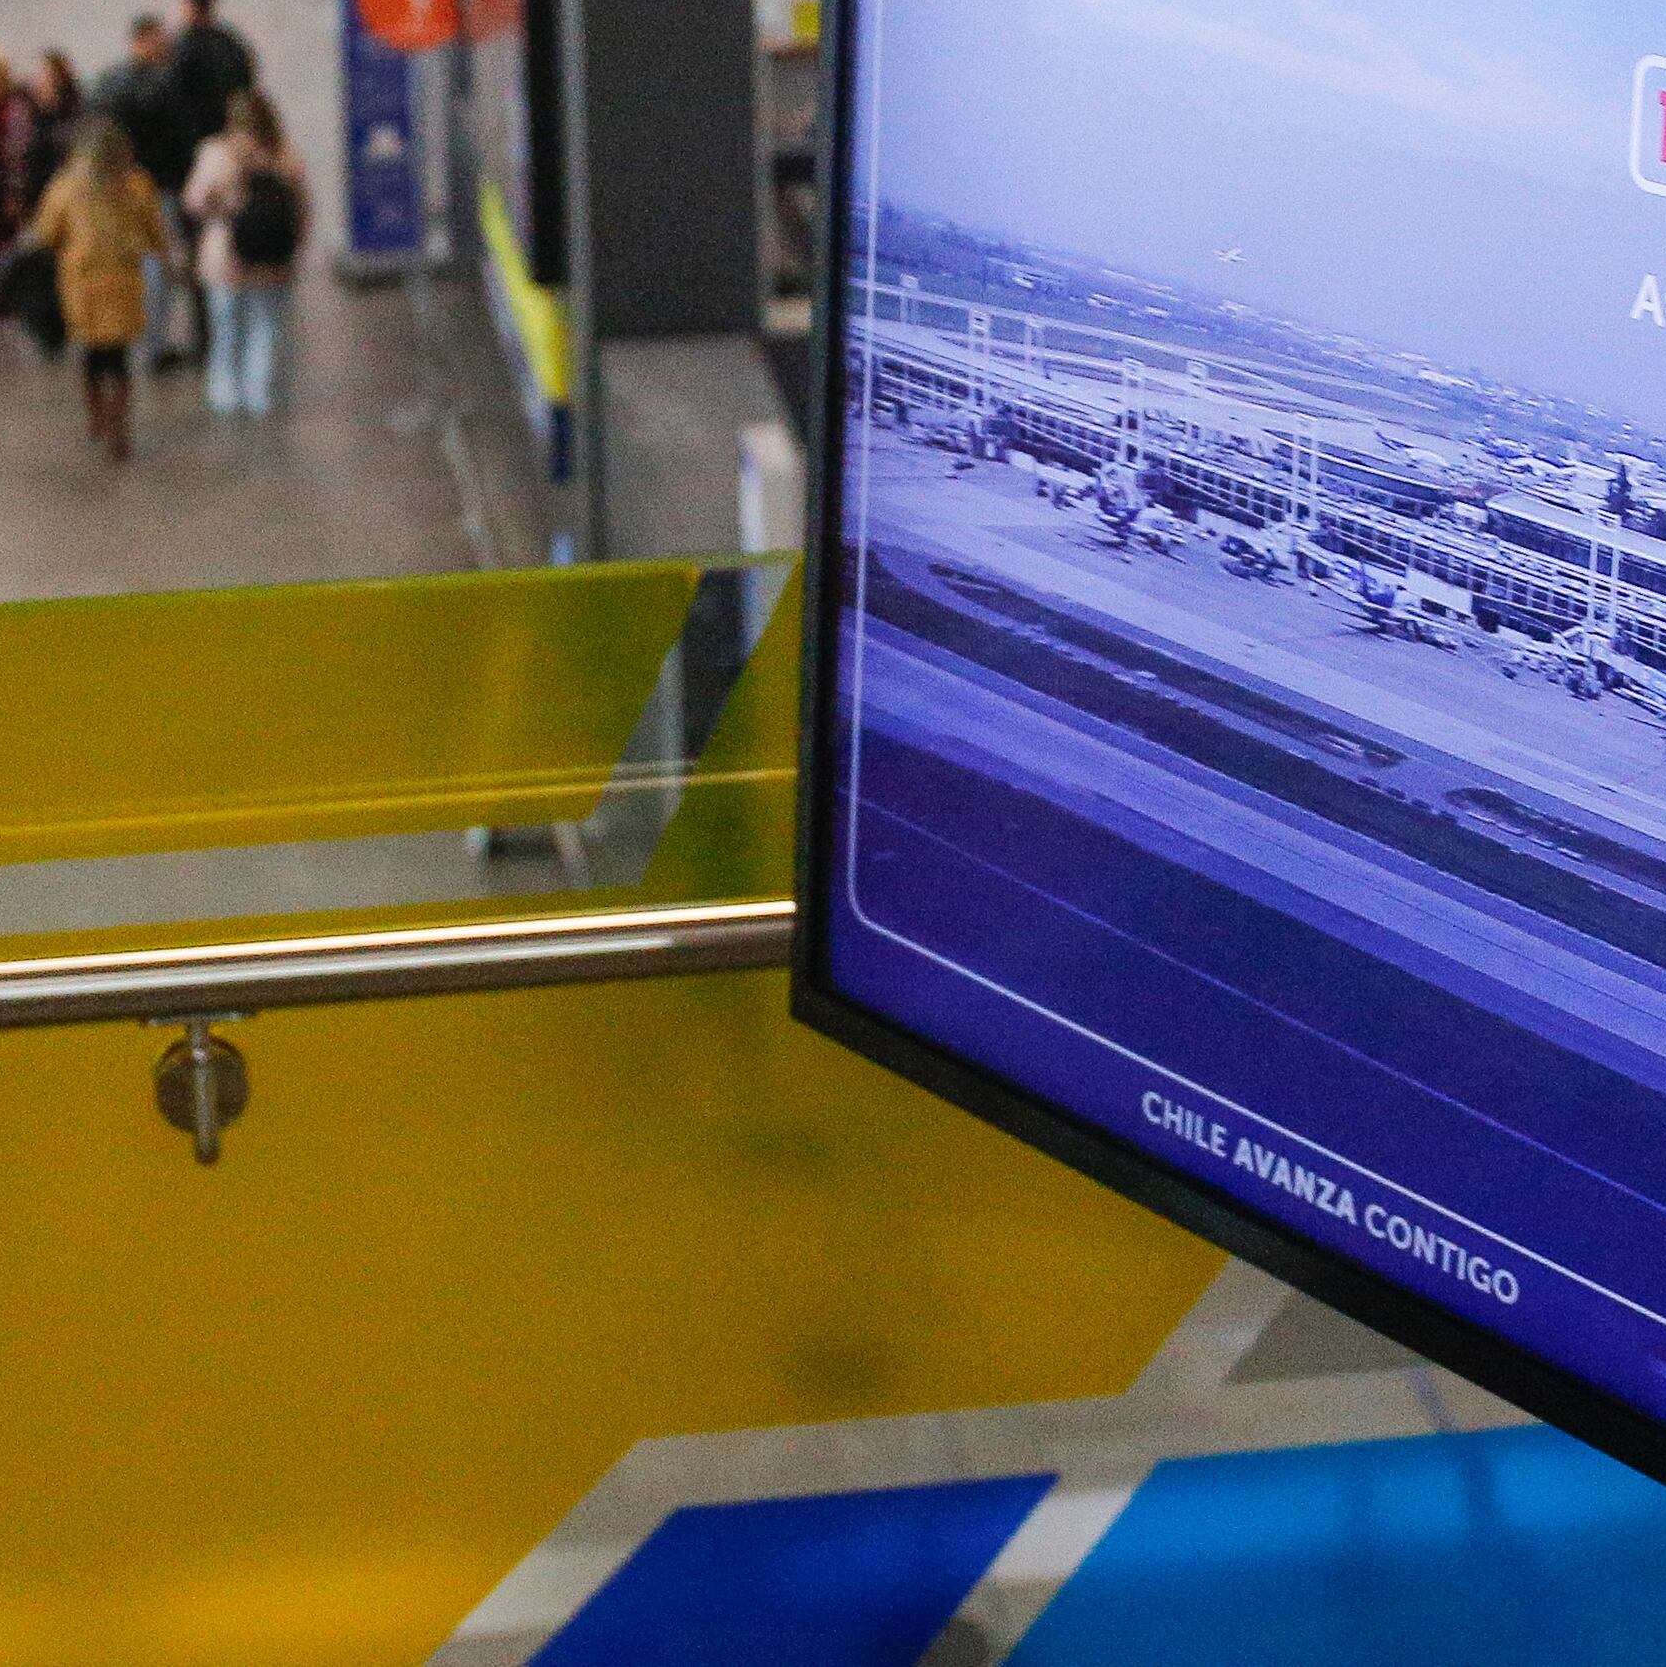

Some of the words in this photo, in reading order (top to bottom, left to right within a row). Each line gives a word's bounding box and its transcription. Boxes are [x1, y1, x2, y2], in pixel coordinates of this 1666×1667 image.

[1141, 1090, 1227, 1158] CHILE
[1233, 1136, 1357, 1227] AVANZA
[1364, 1203, 1520, 1306] CONTIGO
